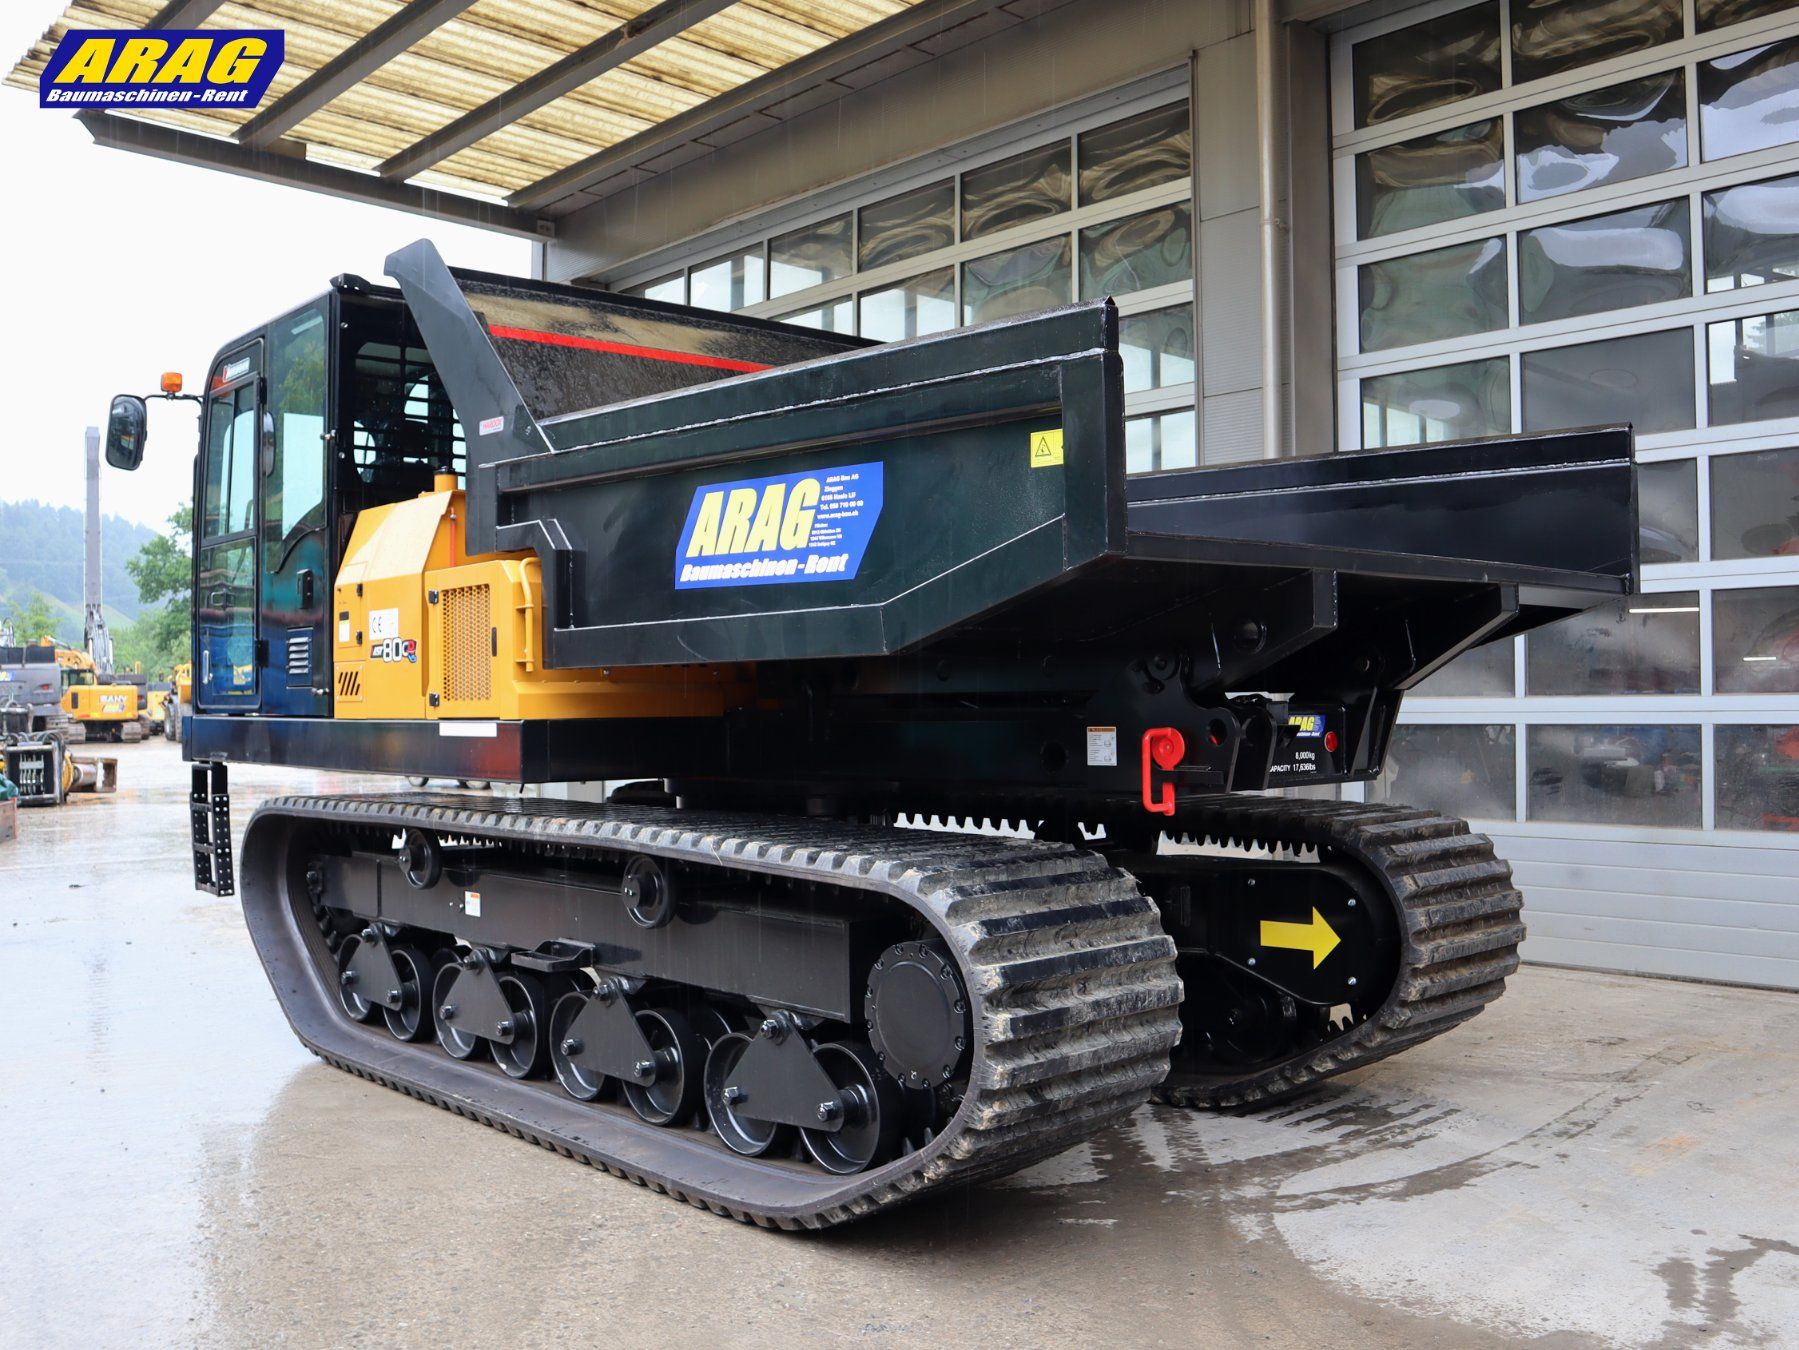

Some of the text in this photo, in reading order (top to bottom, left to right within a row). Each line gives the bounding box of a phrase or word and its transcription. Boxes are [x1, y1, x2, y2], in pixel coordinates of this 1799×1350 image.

[826, 475, 840, 483] ARAG
[686, 478, 821, 558] ARAG
[1269, 764, 1291, 772] APACITY
